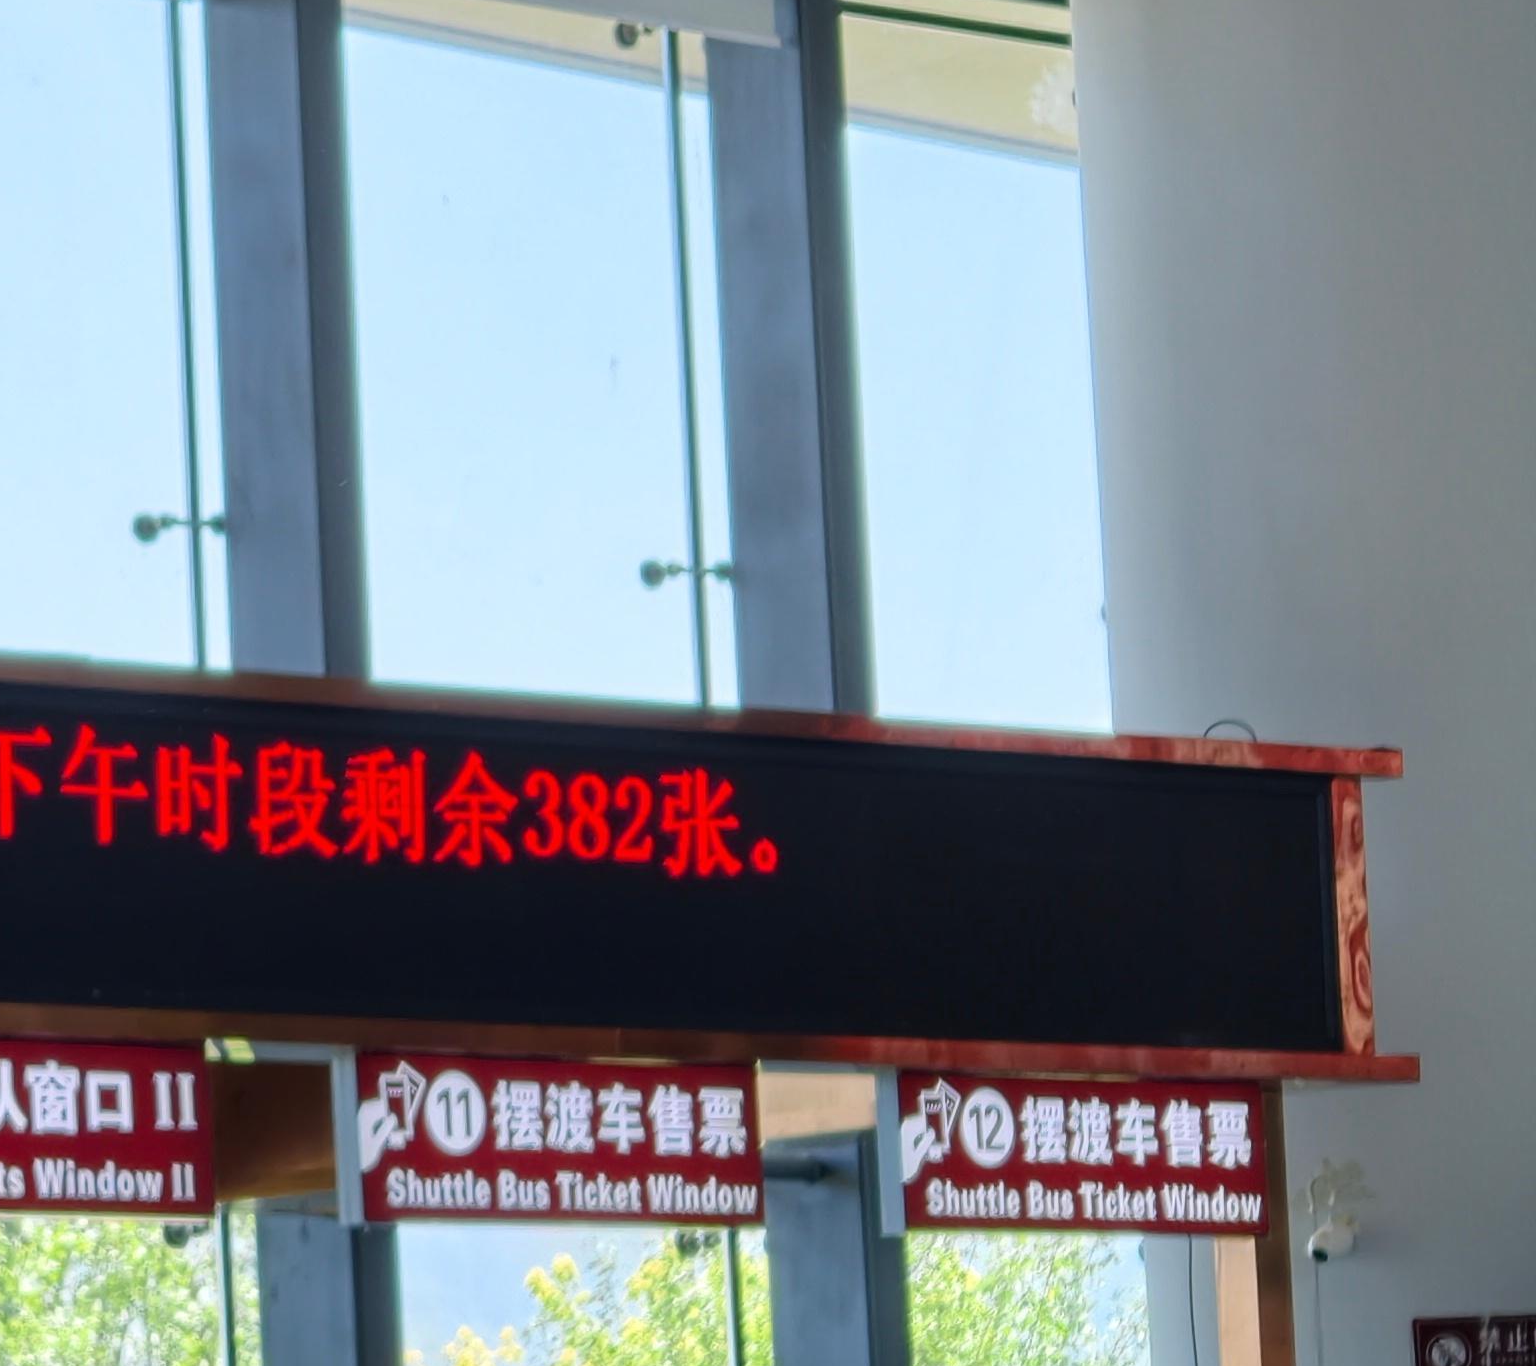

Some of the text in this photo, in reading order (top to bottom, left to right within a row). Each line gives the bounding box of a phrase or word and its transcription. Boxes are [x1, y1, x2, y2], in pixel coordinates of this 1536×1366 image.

[490, 1079, 748, 1158] 摆渡车售票
[1020, 1095, 1253, 1170] 摆渡车售票
[32, 1157, 164, 1202] Window
[386, 1166, 758, 1216] Shuttle Bus Ticket Window
[926, 1177, 1262, 1223] Shuttle Bus Ticket Window
